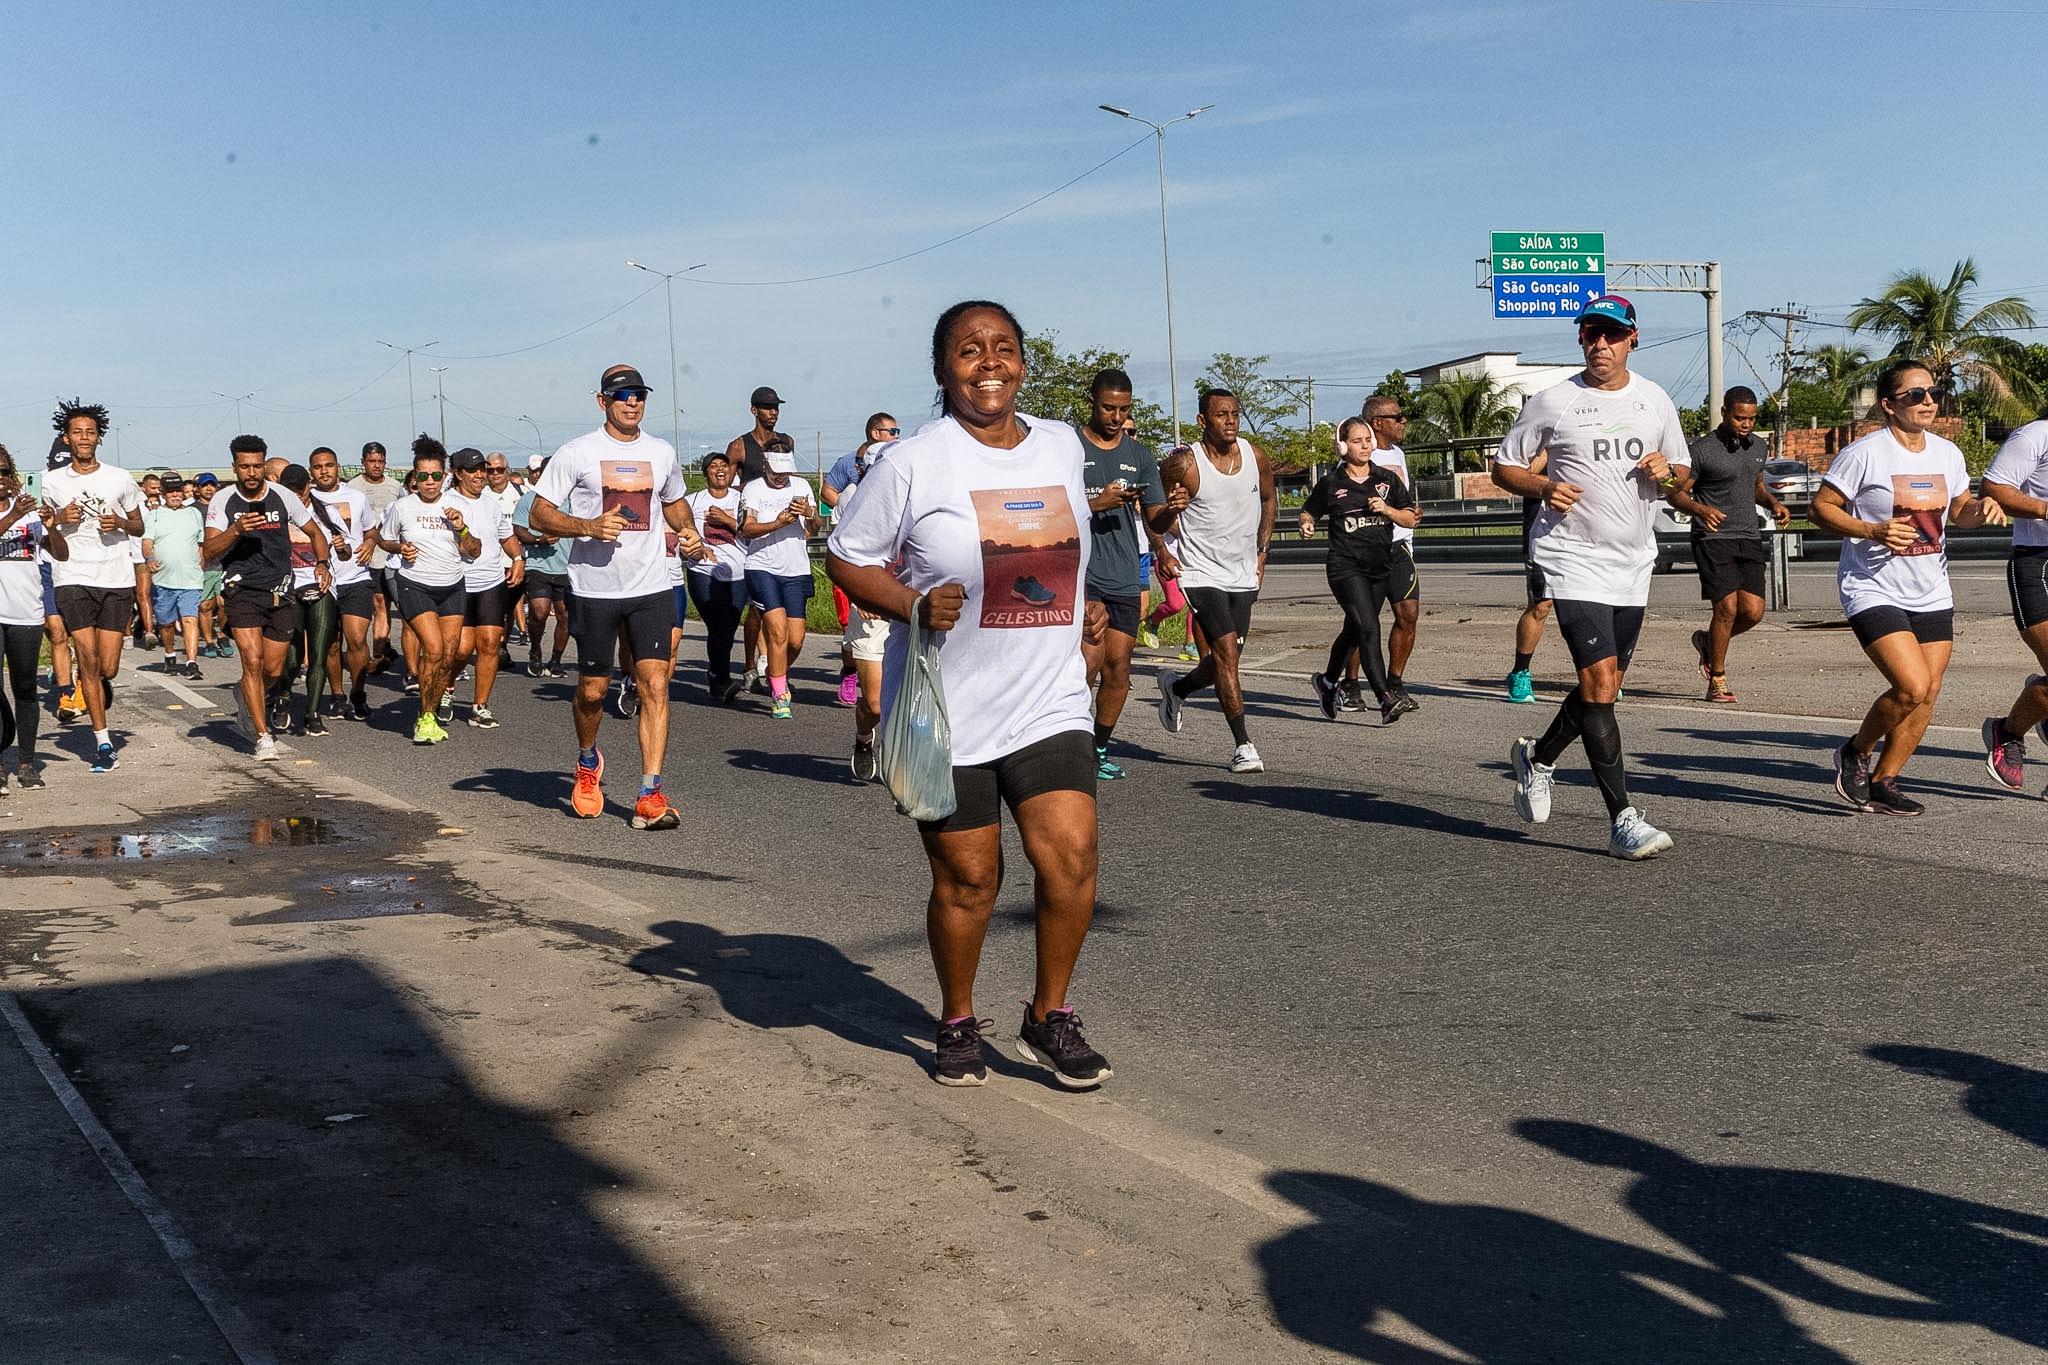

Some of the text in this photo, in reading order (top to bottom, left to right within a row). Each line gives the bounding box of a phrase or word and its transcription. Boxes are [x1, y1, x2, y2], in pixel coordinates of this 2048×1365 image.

[1519, 233, 1578, 250] SAÍDA 313
[1502, 257, 1579, 272] São Gonçalo
[1502, 281, 1580, 296] São Gonçalo
[1498, 298, 1580, 314] Shopping Rio
[1593, 437, 1644, 461] RIO
[1358, 516, 1391, 529] BETA
[983, 609, 1073, 625] CELESTINO
